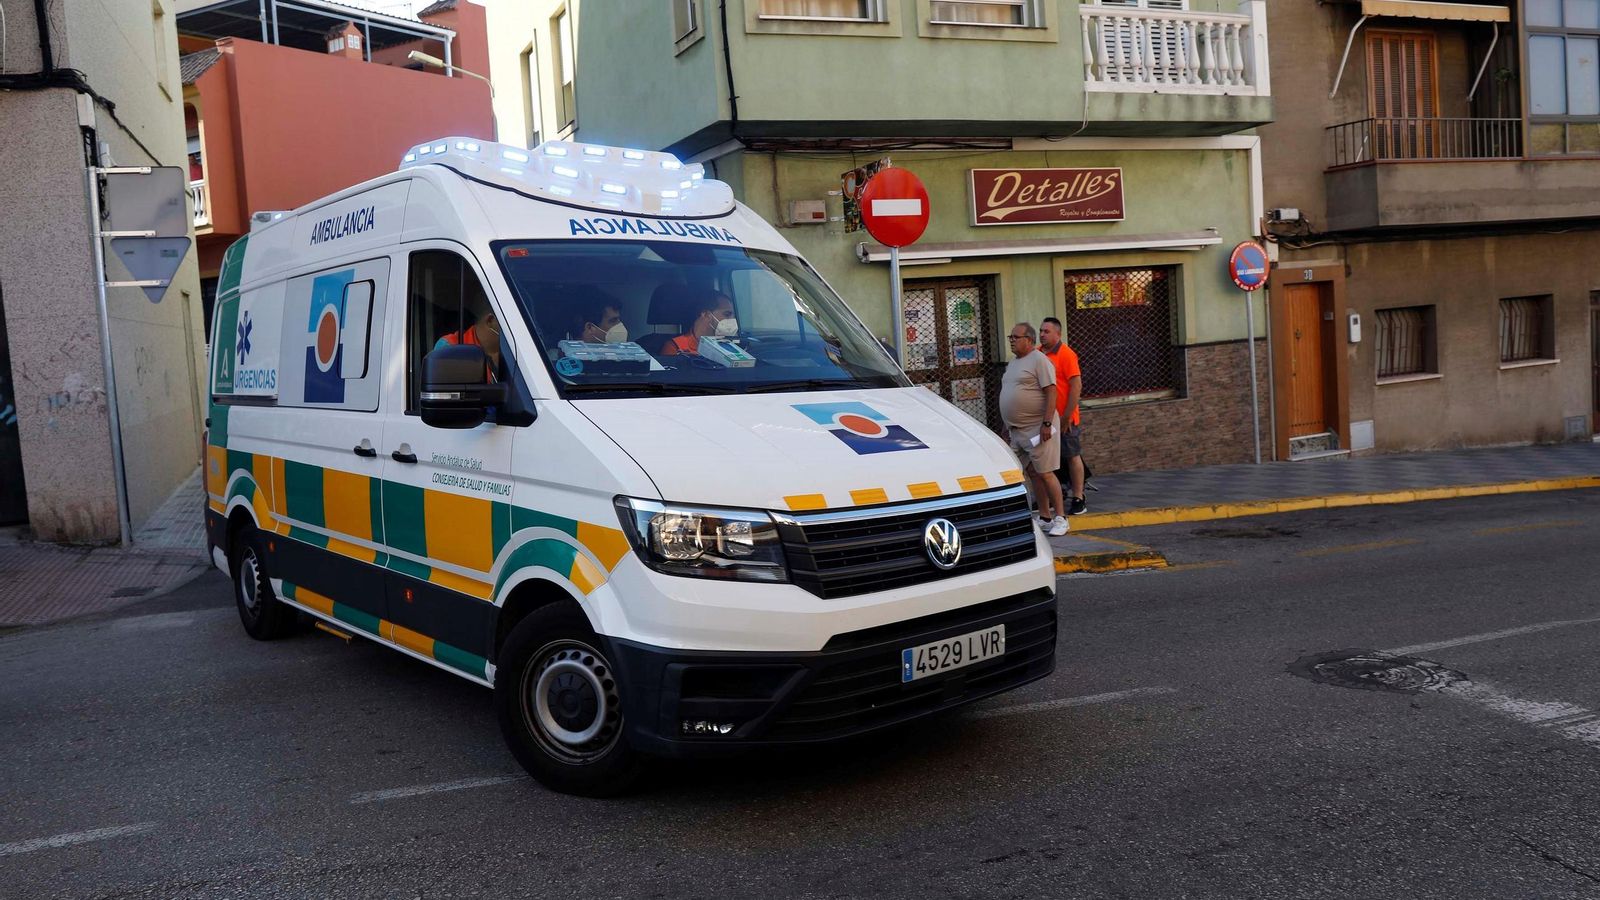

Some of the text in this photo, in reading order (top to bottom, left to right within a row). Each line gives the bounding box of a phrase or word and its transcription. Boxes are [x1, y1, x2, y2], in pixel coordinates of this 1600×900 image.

[986, 172, 1119, 208] Detalles
[309, 205, 375, 246] AMBULANCIA
[234, 369, 276, 389] URGENCIAS
[431, 452, 446, 465] Servicio
[470, 458, 482, 471] Salud
[458, 477, 466, 489] DE
[466, 478, 482, 491] SALUD
[482, 480, 487, 491] Y
[487, 482, 511, 496] FAMILIAS
[916, 630, 1000, 673] 4529 LVR
